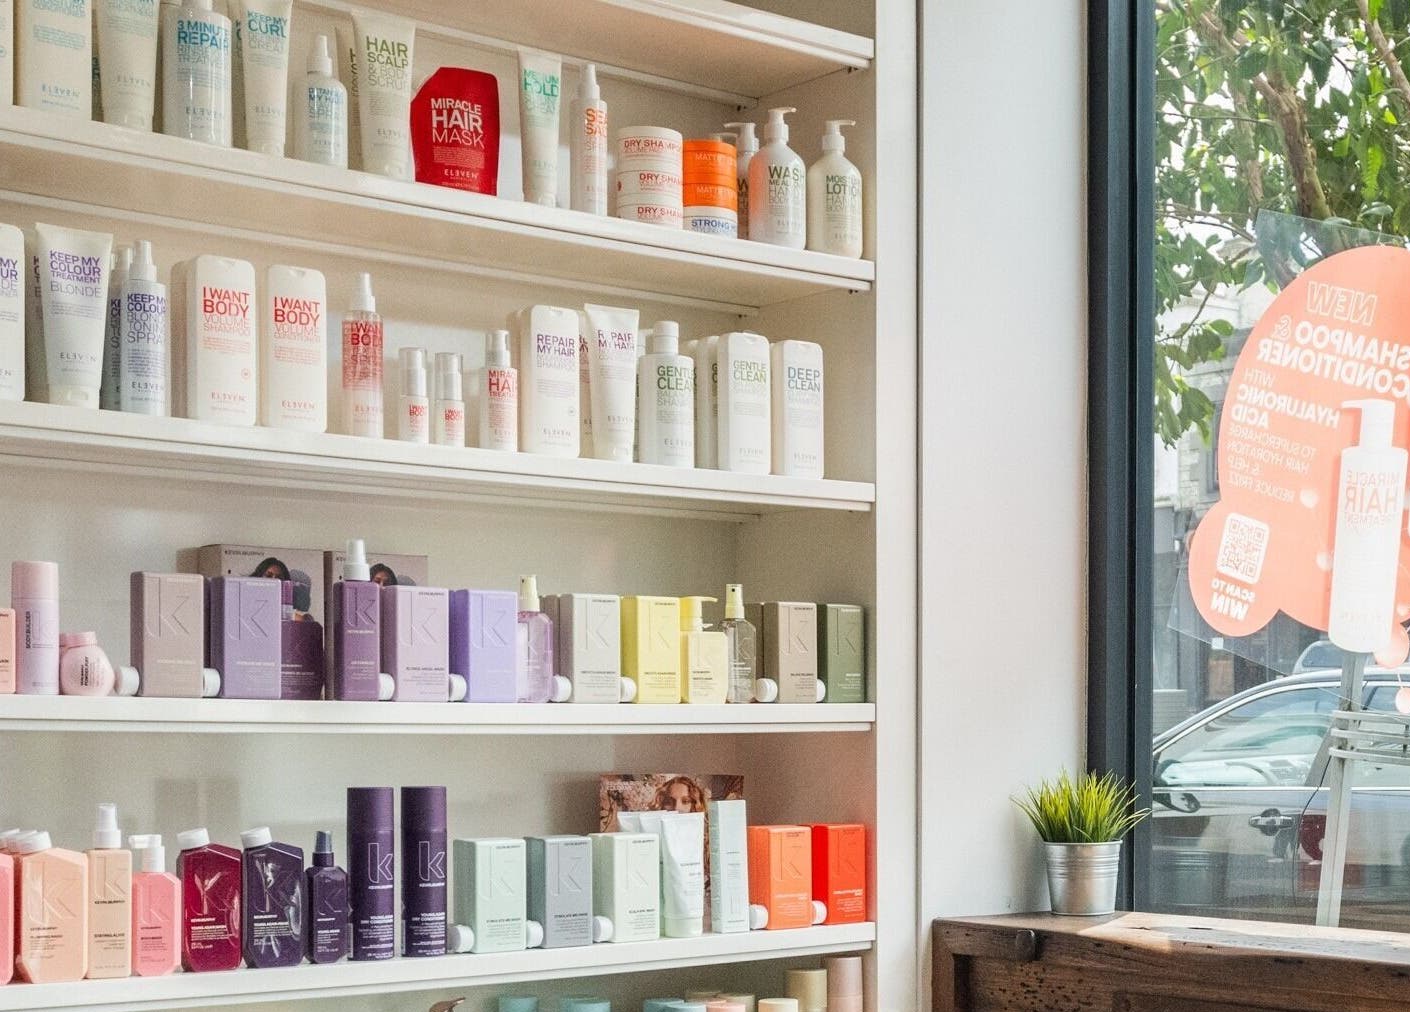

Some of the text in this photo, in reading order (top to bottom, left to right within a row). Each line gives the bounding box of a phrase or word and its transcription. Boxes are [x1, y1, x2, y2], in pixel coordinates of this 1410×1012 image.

[366, 36, 409, 58] HAIR
[367, 53, 409, 69] SCALP
[431, 97, 481, 116] MIRACLE
[432, 110, 483, 135] HAIR
[432, 128, 486, 149] MASK
[624, 140, 641, 149] DRY
[639, 173, 659, 181] DRY
[637, 206, 658, 215] DRY
[691, 219, 729, 231] STRONG
[50, 250, 101, 268] KEEP MY
[50, 261, 101, 277] COLOUR
[51, 270, 101, 285] TREATMENT
[50, 280, 101, 298] BLONDE
[209, 287, 250, 302] WANT
[127, 293, 154, 303] KEEP
[281, 297, 320, 313] WANT
[203, 299, 249, 319] BODY
[274, 308, 320, 326] BODY
[536, 334, 575, 347] REPAIR
[536, 345, 575, 357] MY HAIR
[734, 359, 767, 372] GENTLE
[733, 370, 767, 383] CLEAN
[787, 366, 821, 381] DEEP
[787, 379, 821, 393] CLEAN
